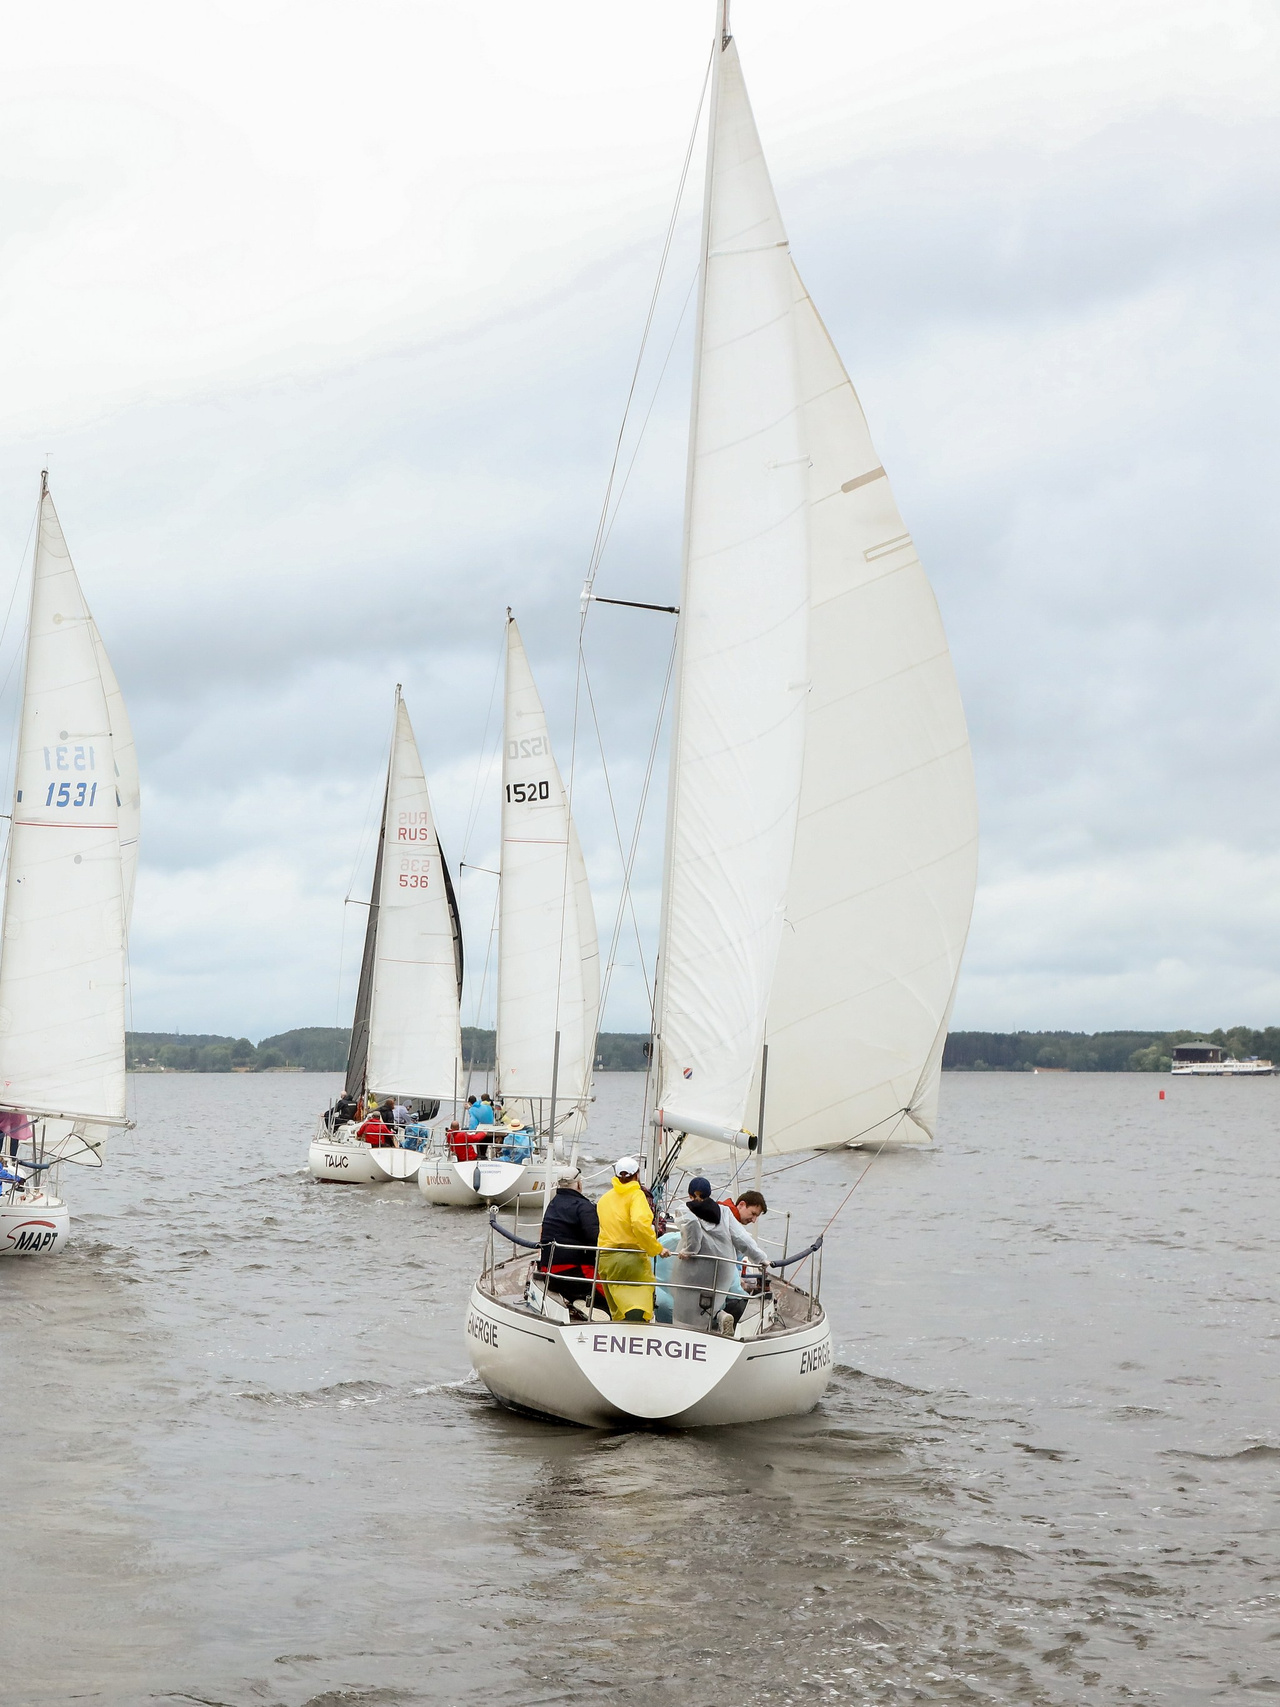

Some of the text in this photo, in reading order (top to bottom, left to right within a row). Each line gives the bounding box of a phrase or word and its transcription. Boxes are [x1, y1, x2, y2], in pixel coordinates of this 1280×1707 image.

[45, 782, 97, 807] 1531
[506, 781, 549, 803] 1520
[398, 827, 428, 841] RUS
[399, 874, 429, 889] 536
[593, 1335, 707, 1362] ENERGIE
